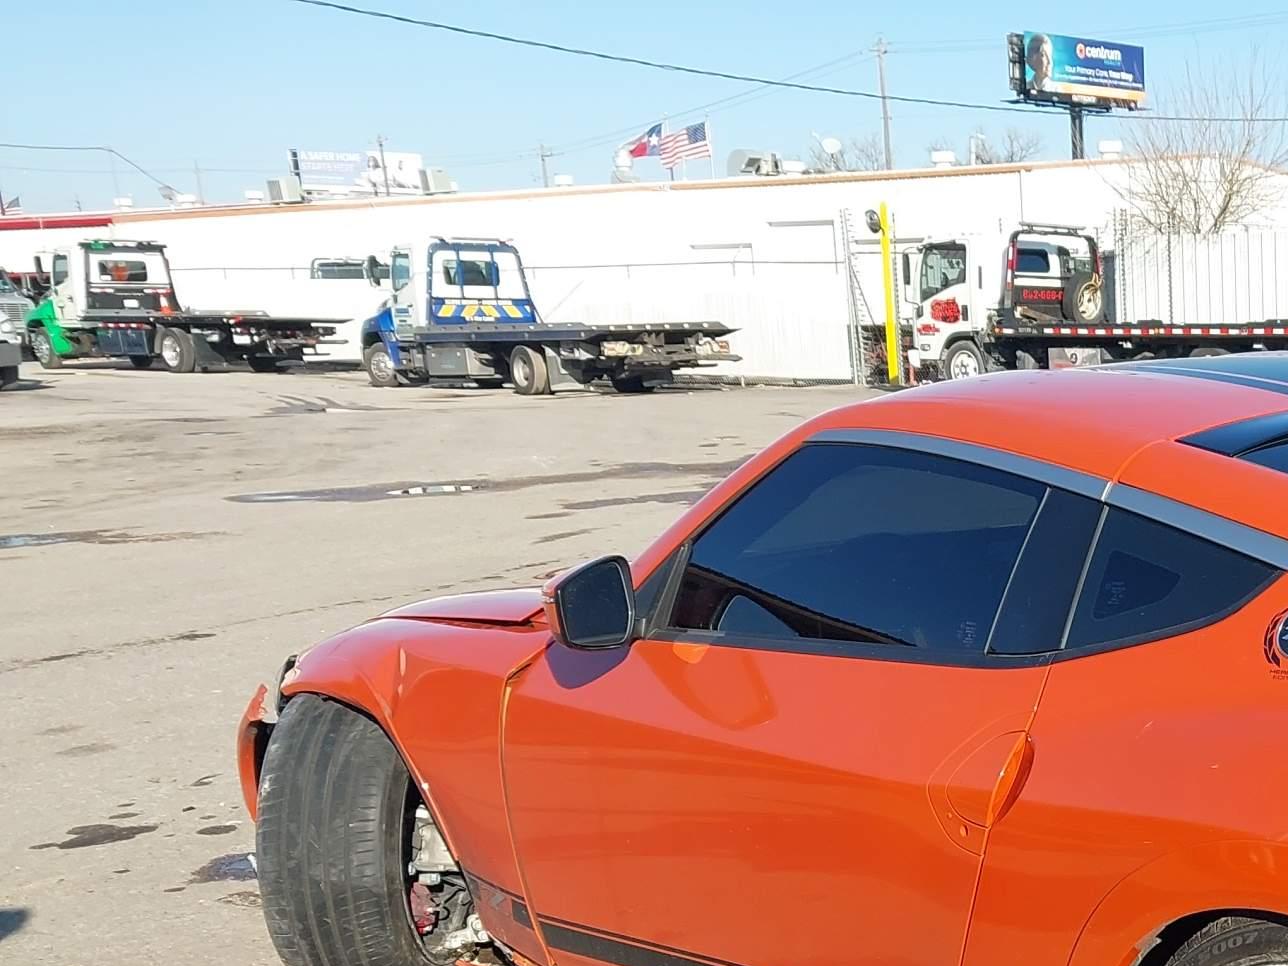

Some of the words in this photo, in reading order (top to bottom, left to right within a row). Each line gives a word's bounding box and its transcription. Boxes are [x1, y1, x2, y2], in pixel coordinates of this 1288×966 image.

[1086, 46, 1121, 61] centrum
[1065, 65, 1076, 73] Your
[1077, 66, 1095, 76] Primary
